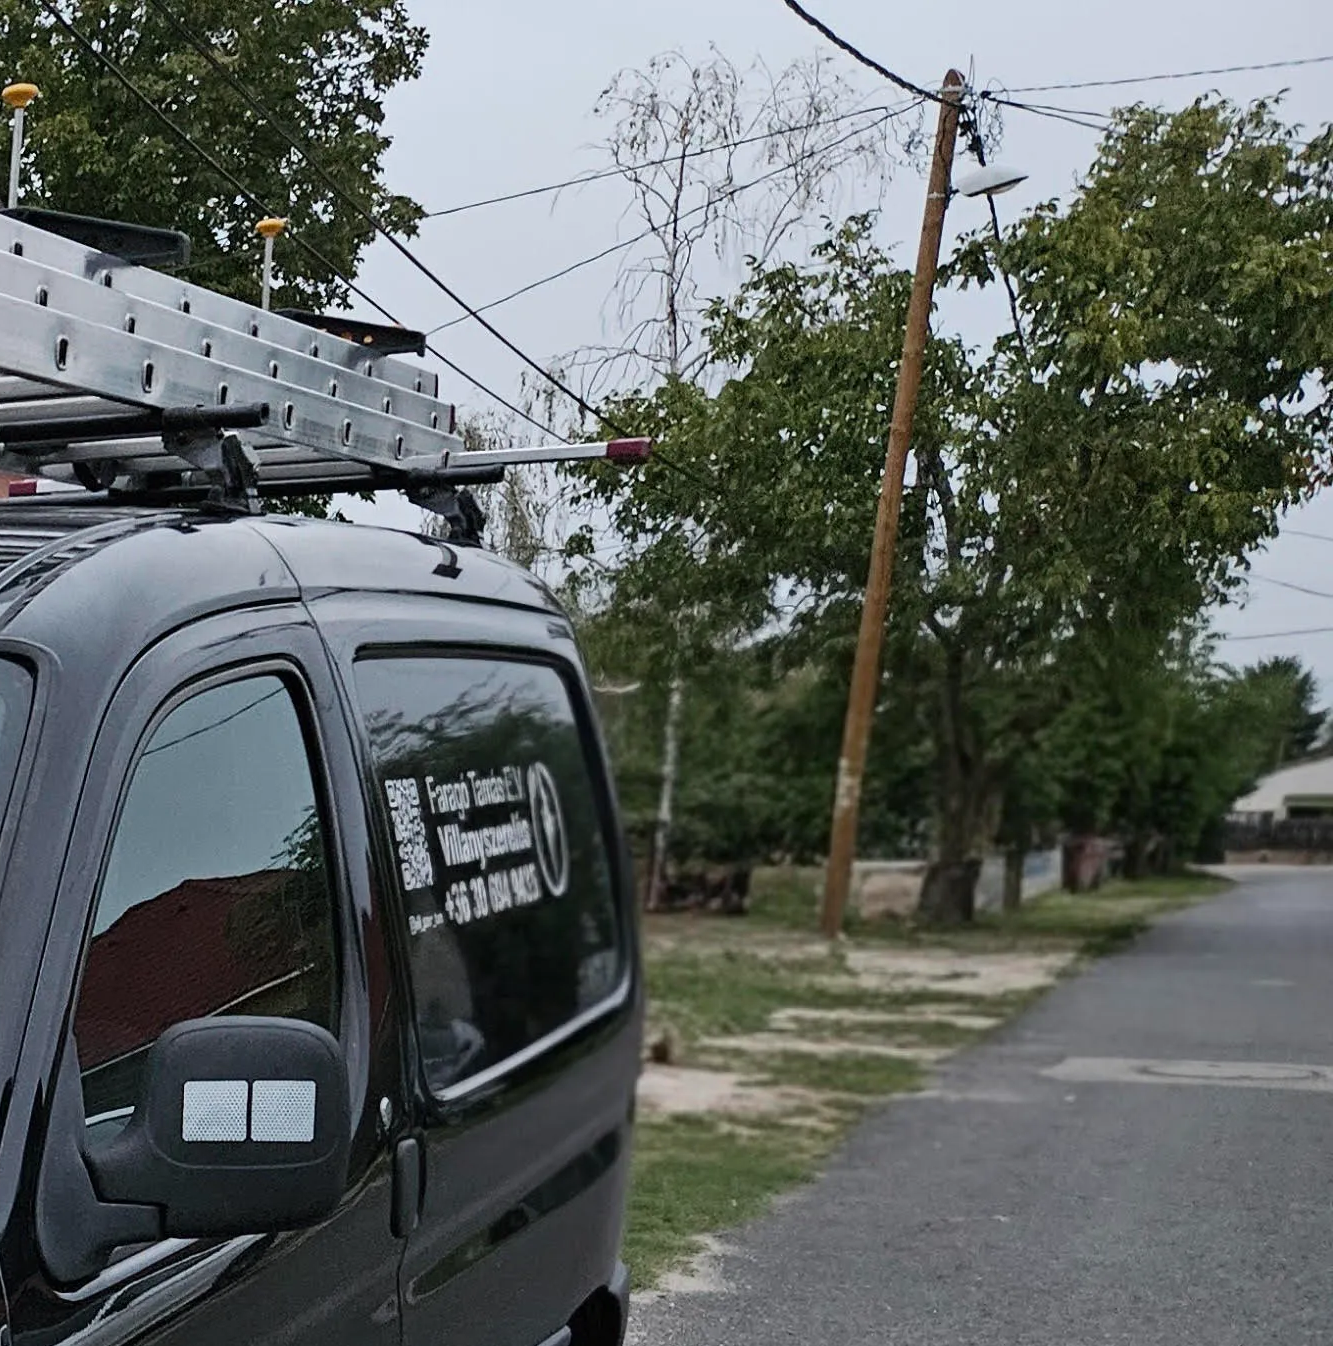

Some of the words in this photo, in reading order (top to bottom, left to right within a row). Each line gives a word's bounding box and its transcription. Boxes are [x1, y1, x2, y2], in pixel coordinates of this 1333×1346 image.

[425, 772, 471, 821] Faragó
[466, 768, 506, 807] Tamás
[436, 811, 532, 870] Villanyszerelés
[445, 881, 471, 925] +36
